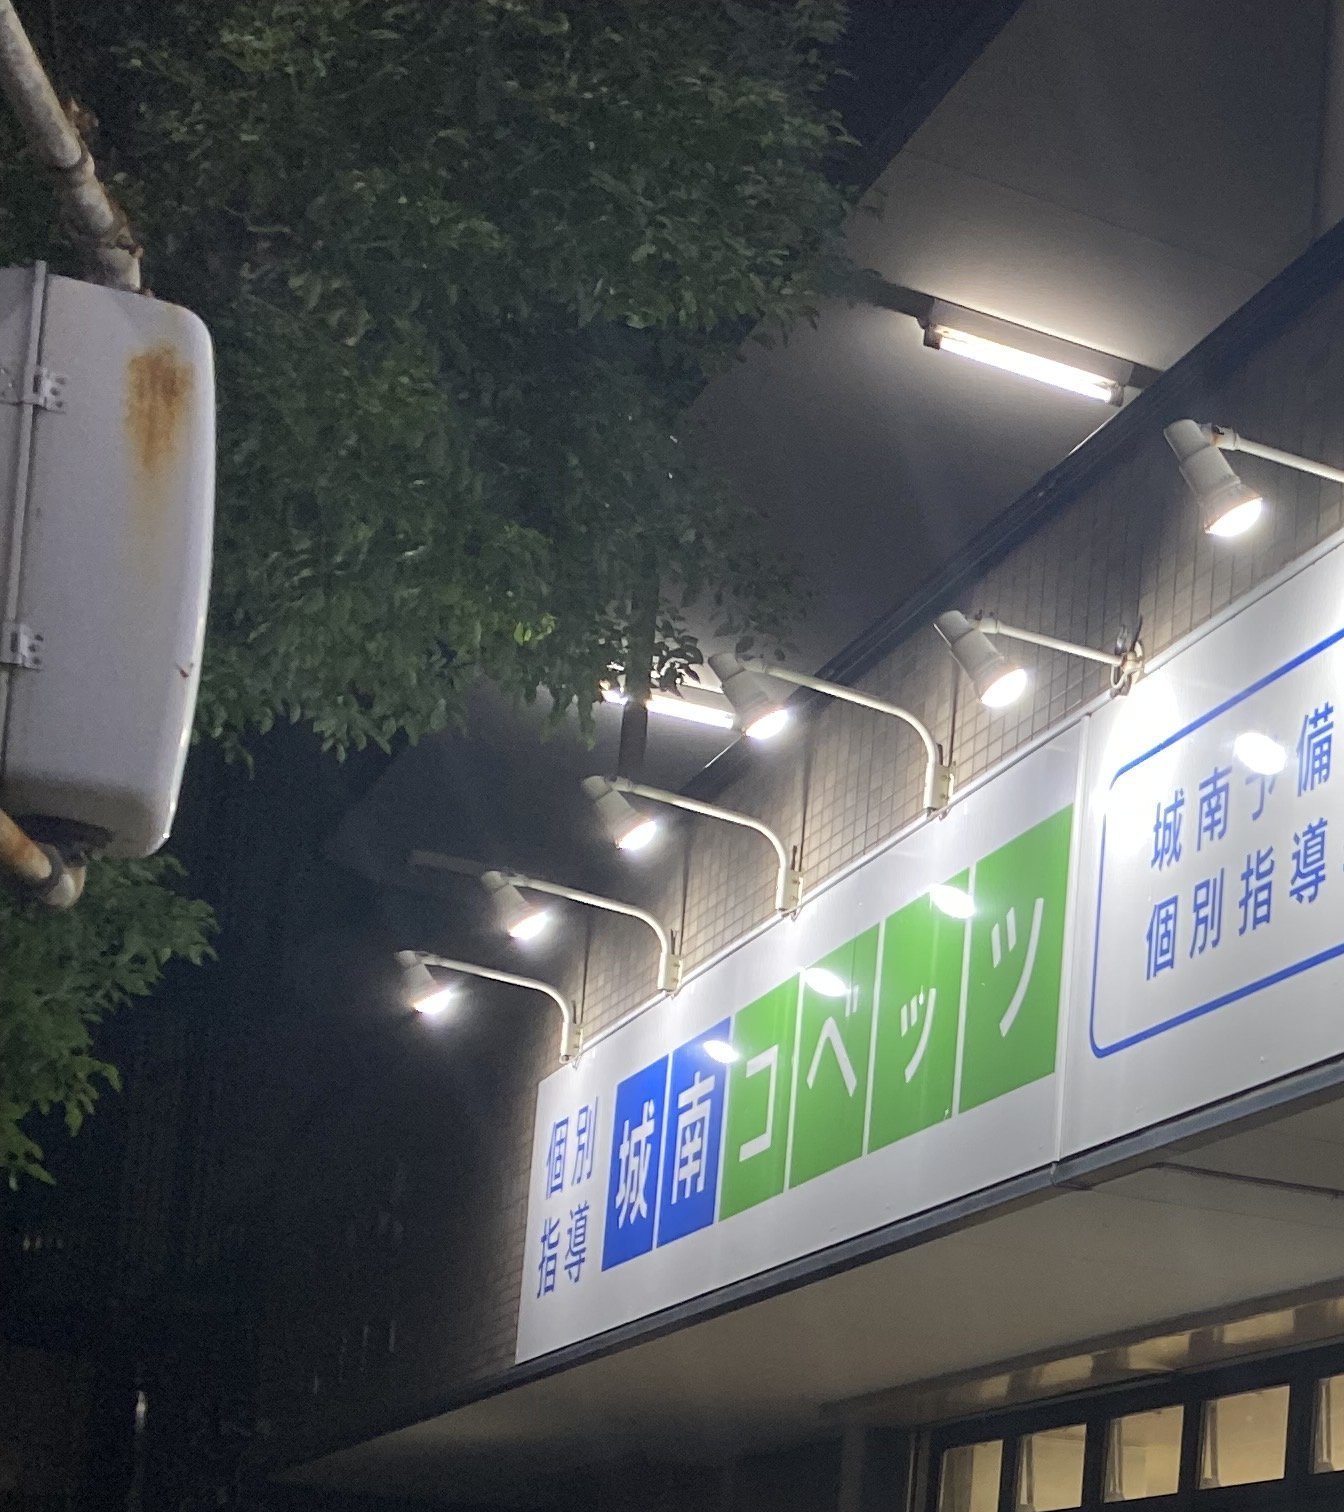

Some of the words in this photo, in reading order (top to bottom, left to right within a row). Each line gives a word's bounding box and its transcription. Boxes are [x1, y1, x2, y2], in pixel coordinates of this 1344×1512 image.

[614, 892, 1045, 1232] 城南コベッツ
[543, 1094, 599, 1199] 個別
[535, 1203, 591, 1300] 指導
